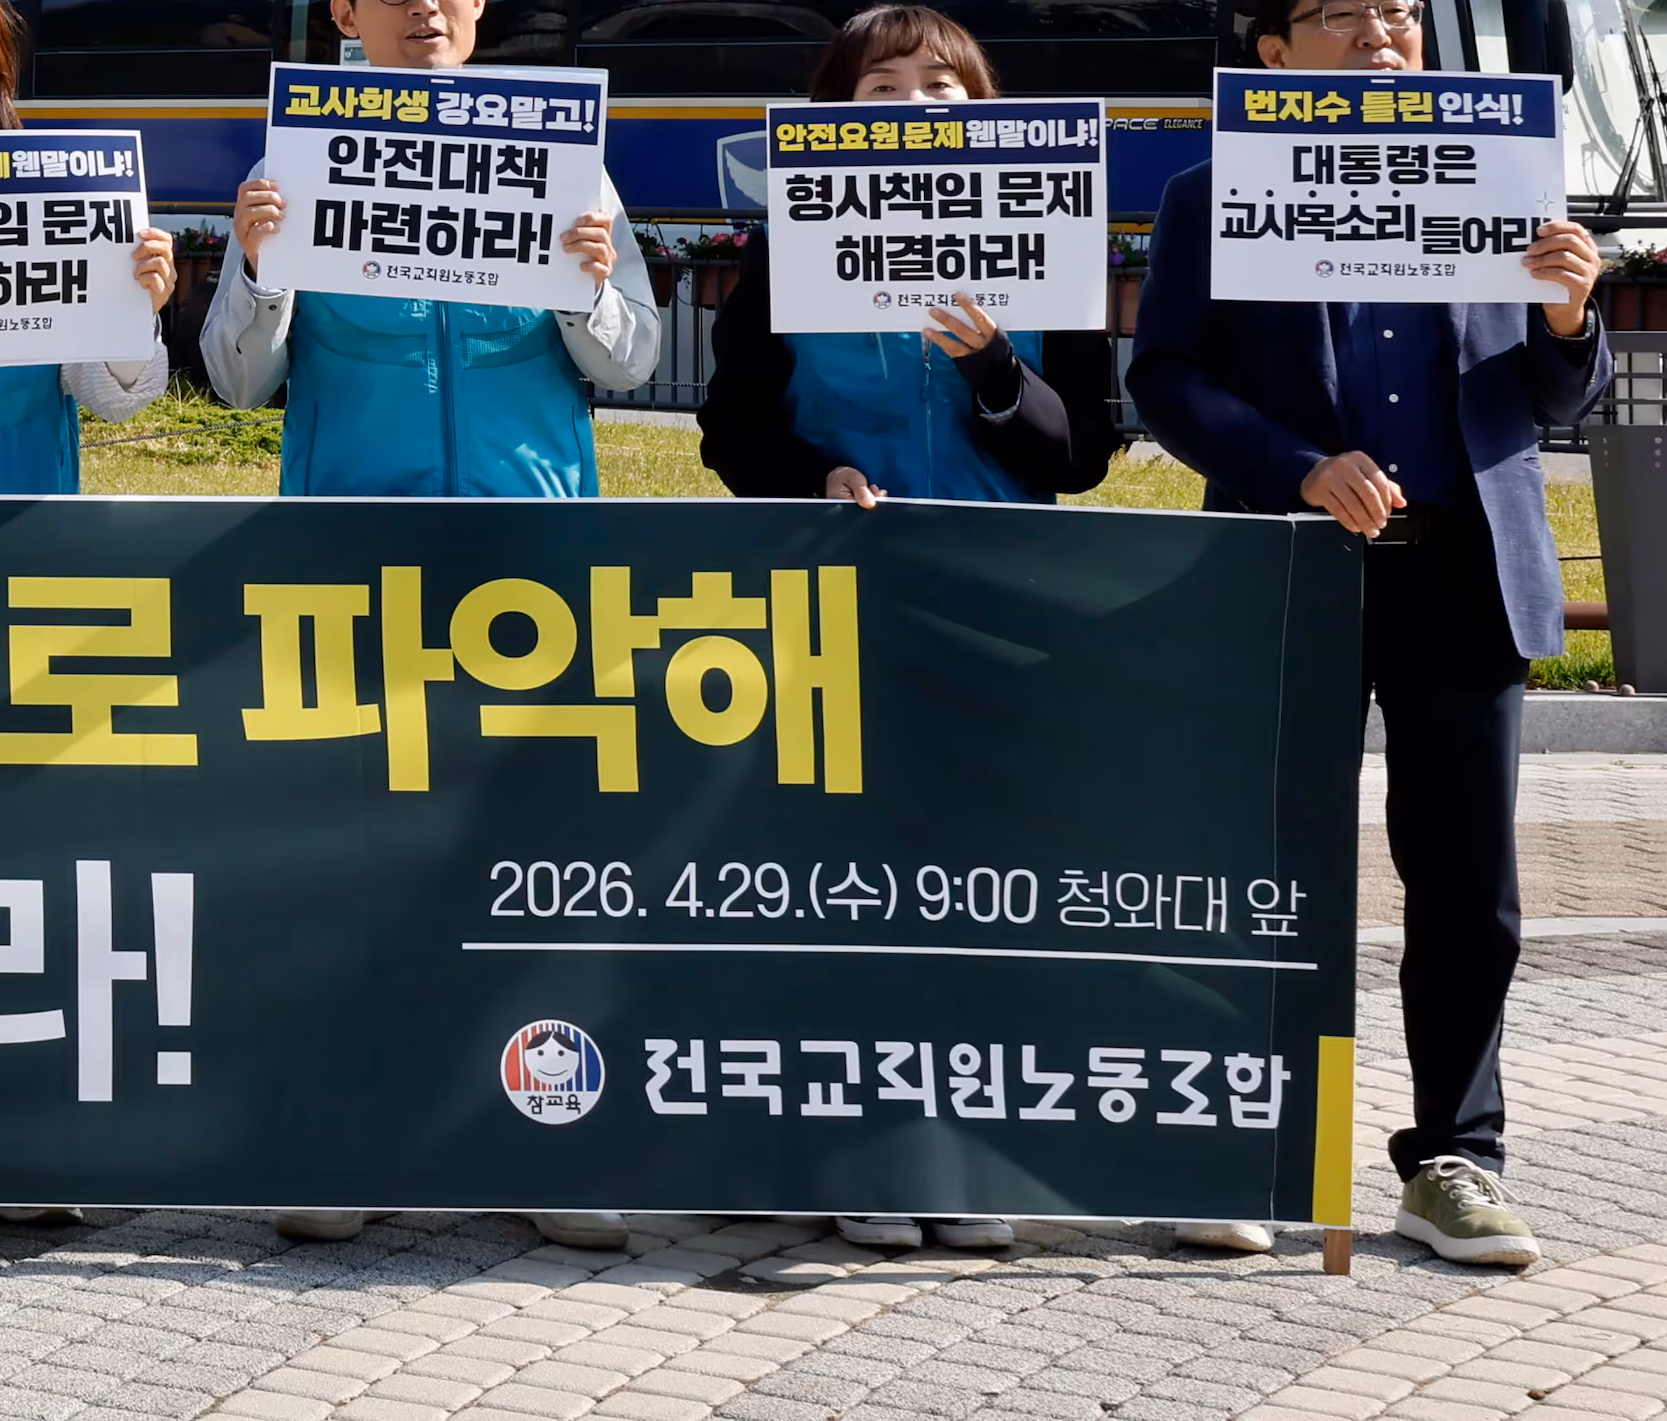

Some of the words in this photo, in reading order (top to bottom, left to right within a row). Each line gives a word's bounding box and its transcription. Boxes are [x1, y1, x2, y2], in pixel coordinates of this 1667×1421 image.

[285, 83, 431, 124] 교사희생
[435, 90, 596, 133] 강요말고!
[1106, 118, 1159, 130] PACE
[1164, 119, 1203, 129] ELEGANCE
[1244, 89, 1351, 123] 번지수
[1360, 90, 1434, 123] 틀린
[1438, 92, 1525, 126] 인식!
[966, 118, 1100, 148] 웬말이냐!
[11, 150, 135, 178] 웬말이냐!
[327, 135, 549, 199] 안전대책
[1292, 144, 1476, 185] 대통령은
[786, 172, 982, 222] 형사책임
[997, 170, 1093, 219] 문제
[42, 199, 135, 245] 문제
[313, 199, 554, 265] 마련하라!
[1220, 201, 1416, 242] 교사목소리
[1421, 216, 1552, 255] 들어라
[386, 267, 500, 286] 전국교직원노동조합
[836, 233, 1045, 282] 해결하라!
[1340, 262, 1456, 277] 전국교직원노동조합
[241, 564, 864, 795] 파악해
[487, 859, 648, 920] 2026.
[665, 859, 900, 924] 4.29.(수)
[915, 865, 1038, 926] 9:00
[1055, 868, 1229, 936] 청와대
[1246, 876, 1308, 939] 앞
[527, 1094, 581, 1115] 참교육
[644, 1036, 1293, 1130] 전국교직원노동조합
